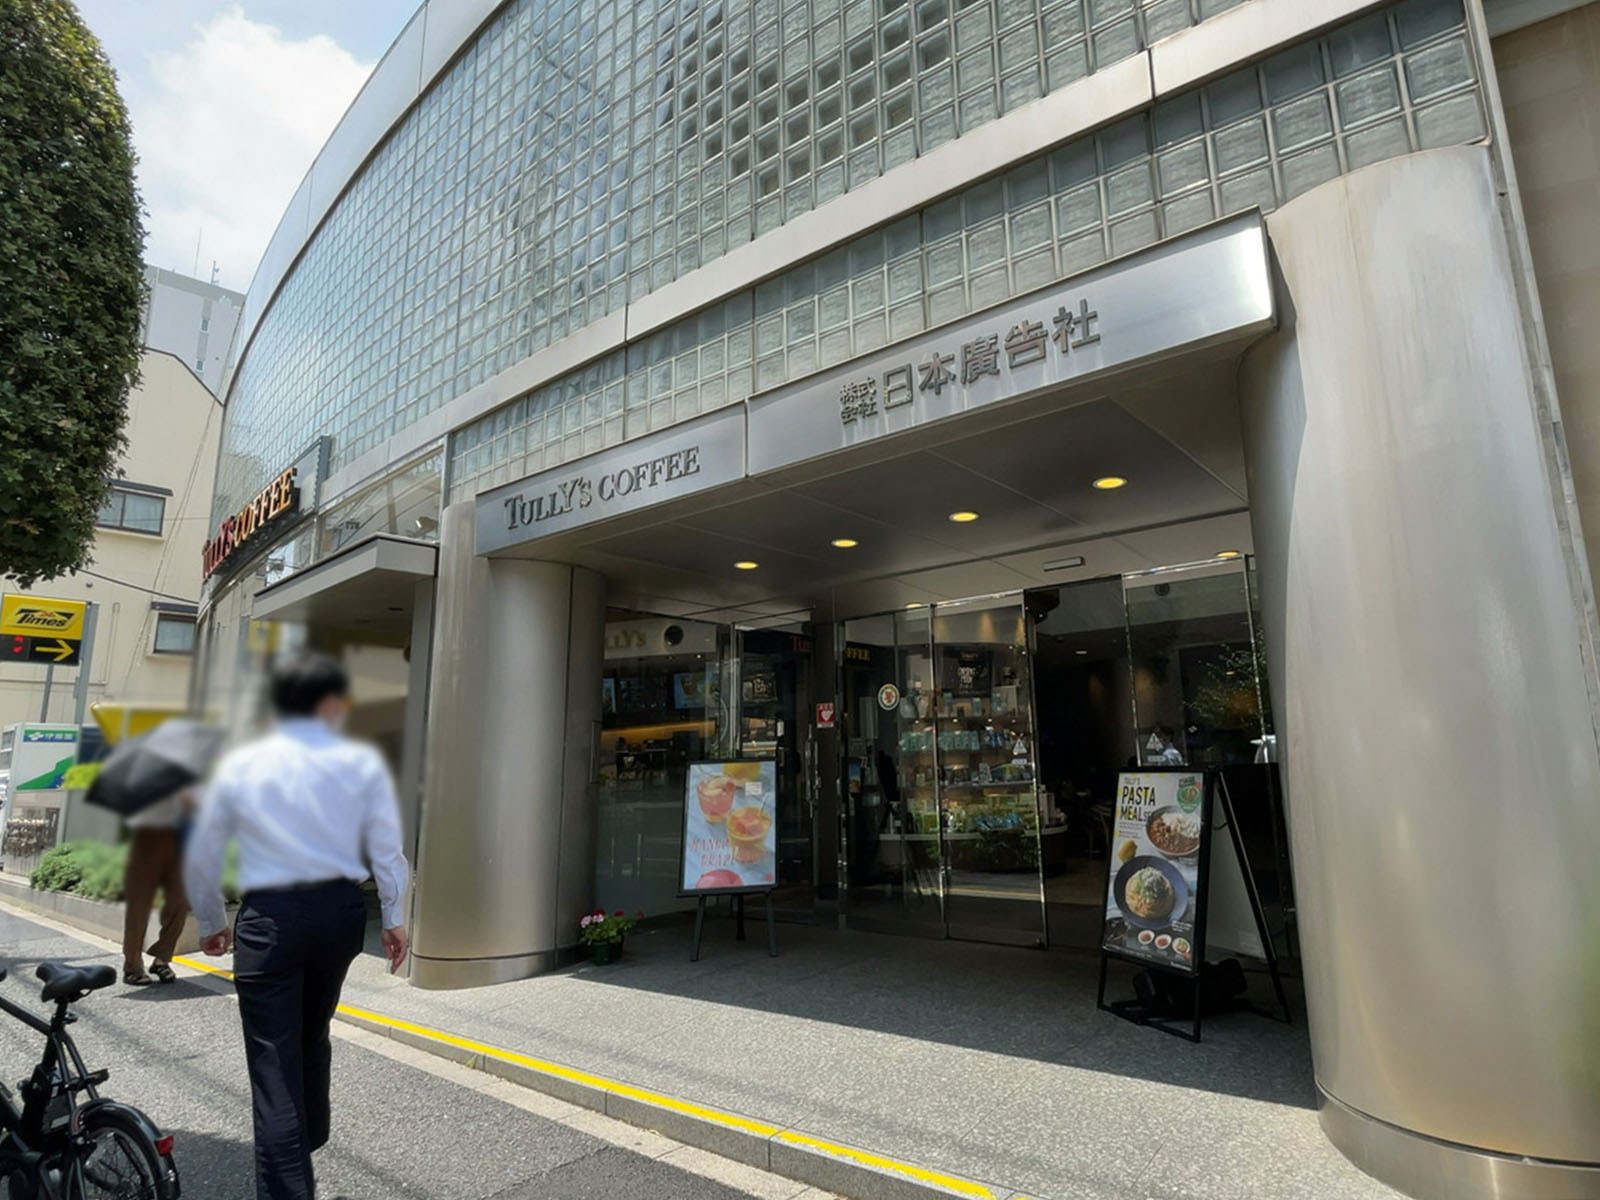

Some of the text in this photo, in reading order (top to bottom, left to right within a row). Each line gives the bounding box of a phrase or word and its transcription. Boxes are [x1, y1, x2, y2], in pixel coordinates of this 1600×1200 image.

[883, 299, 1102, 410] 日本廣告社
[598, 446, 701, 501] COFFEE
[233, 466, 297, 548] COFFEE
[15, 608, 71, 628] Times
[1120, 807, 1143, 821] MEAL
[1122, 786, 1156, 806] PASTA
